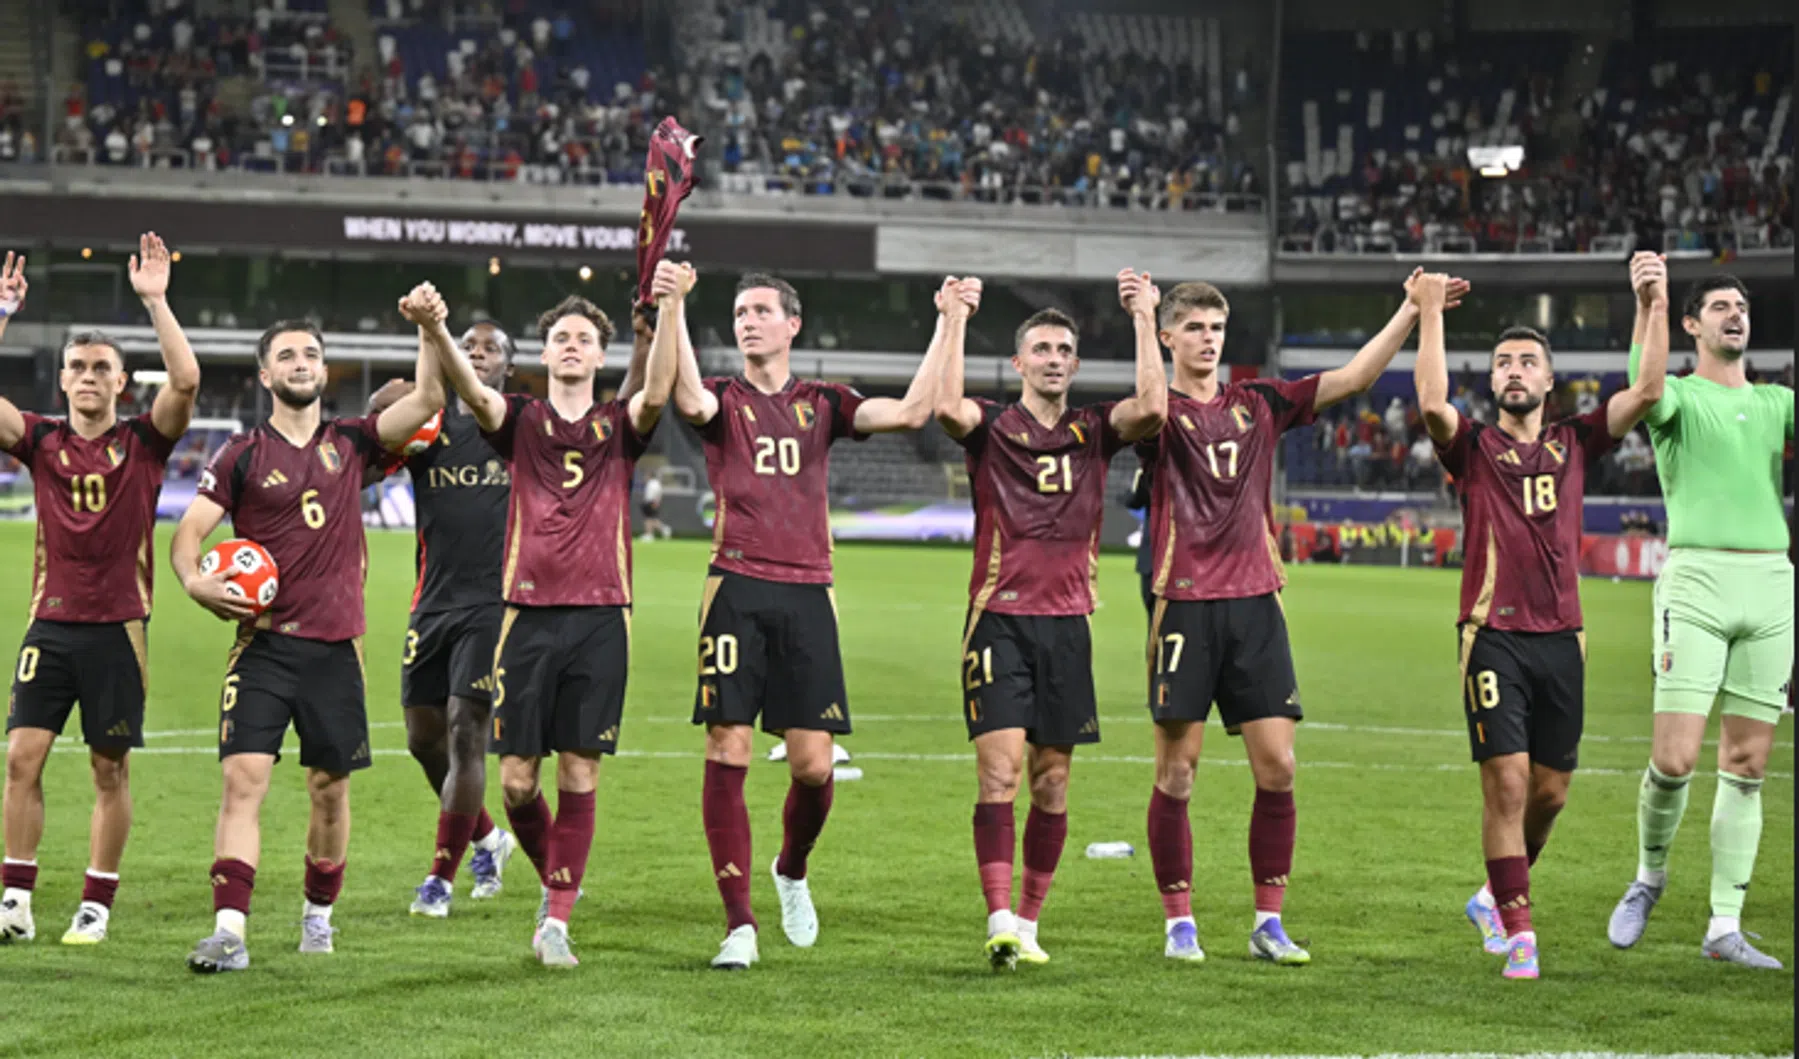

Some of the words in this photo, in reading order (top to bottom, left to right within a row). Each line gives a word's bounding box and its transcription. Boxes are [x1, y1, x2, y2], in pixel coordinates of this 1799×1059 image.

[344, 216, 401, 241] WHEN
[405, 218, 446, 243] YOU
[448, 220, 523, 249] WORRY,
[524, 224, 580, 248] MOVE
[581, 226, 634, 249] YOUR
[562, 451, 585, 489] 5
[755, 436, 801, 475] 20
[1036, 455, 1073, 493] 21
[1206, 440, 1239, 479] 17
[70, 474, 107, 513] 10
[428, 464, 479, 489] ING
[1523, 474, 1557, 514] 18
[302, 489, 326, 529] 6
[698, 633, 738, 675] 20
[965, 646, 993, 690] 21
[1156, 633, 1185, 675] 17
[223, 674, 241, 711] 6
[493, 667, 506, 708] 5
[1467, 670, 1499, 713] 18
